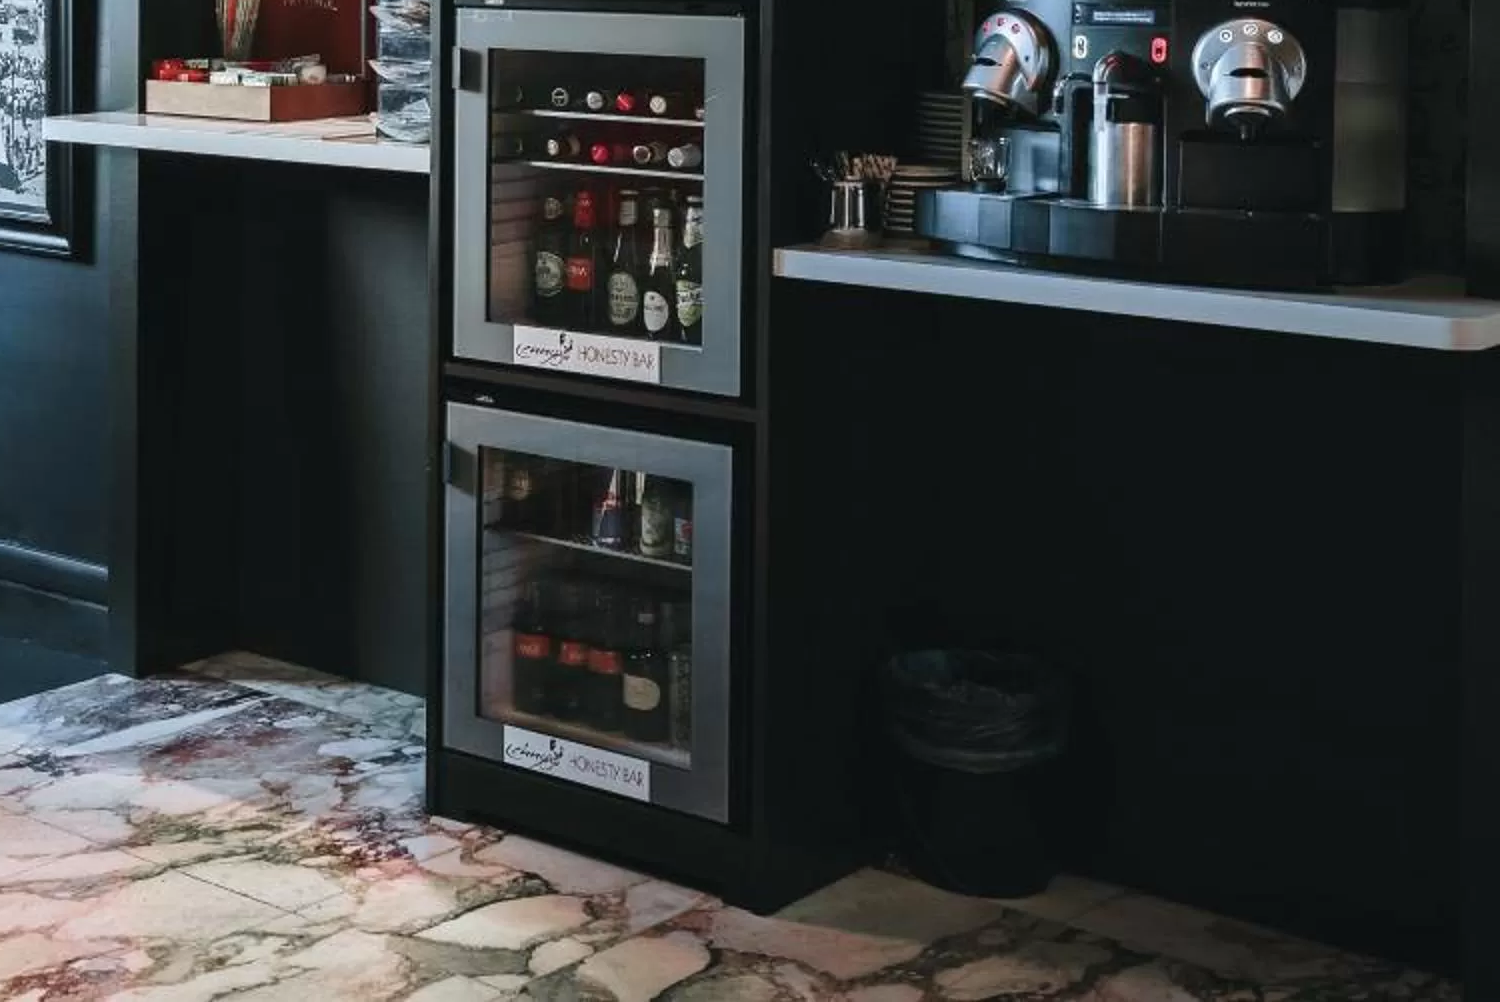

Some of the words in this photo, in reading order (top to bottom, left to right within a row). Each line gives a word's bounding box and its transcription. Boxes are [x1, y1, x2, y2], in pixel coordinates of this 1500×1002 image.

[577, 345, 631, 367] HONESTY
[632, 351, 656, 371] BAR
[569, 752, 621, 781] HONESTY
[623, 768, 645, 787] BAR
